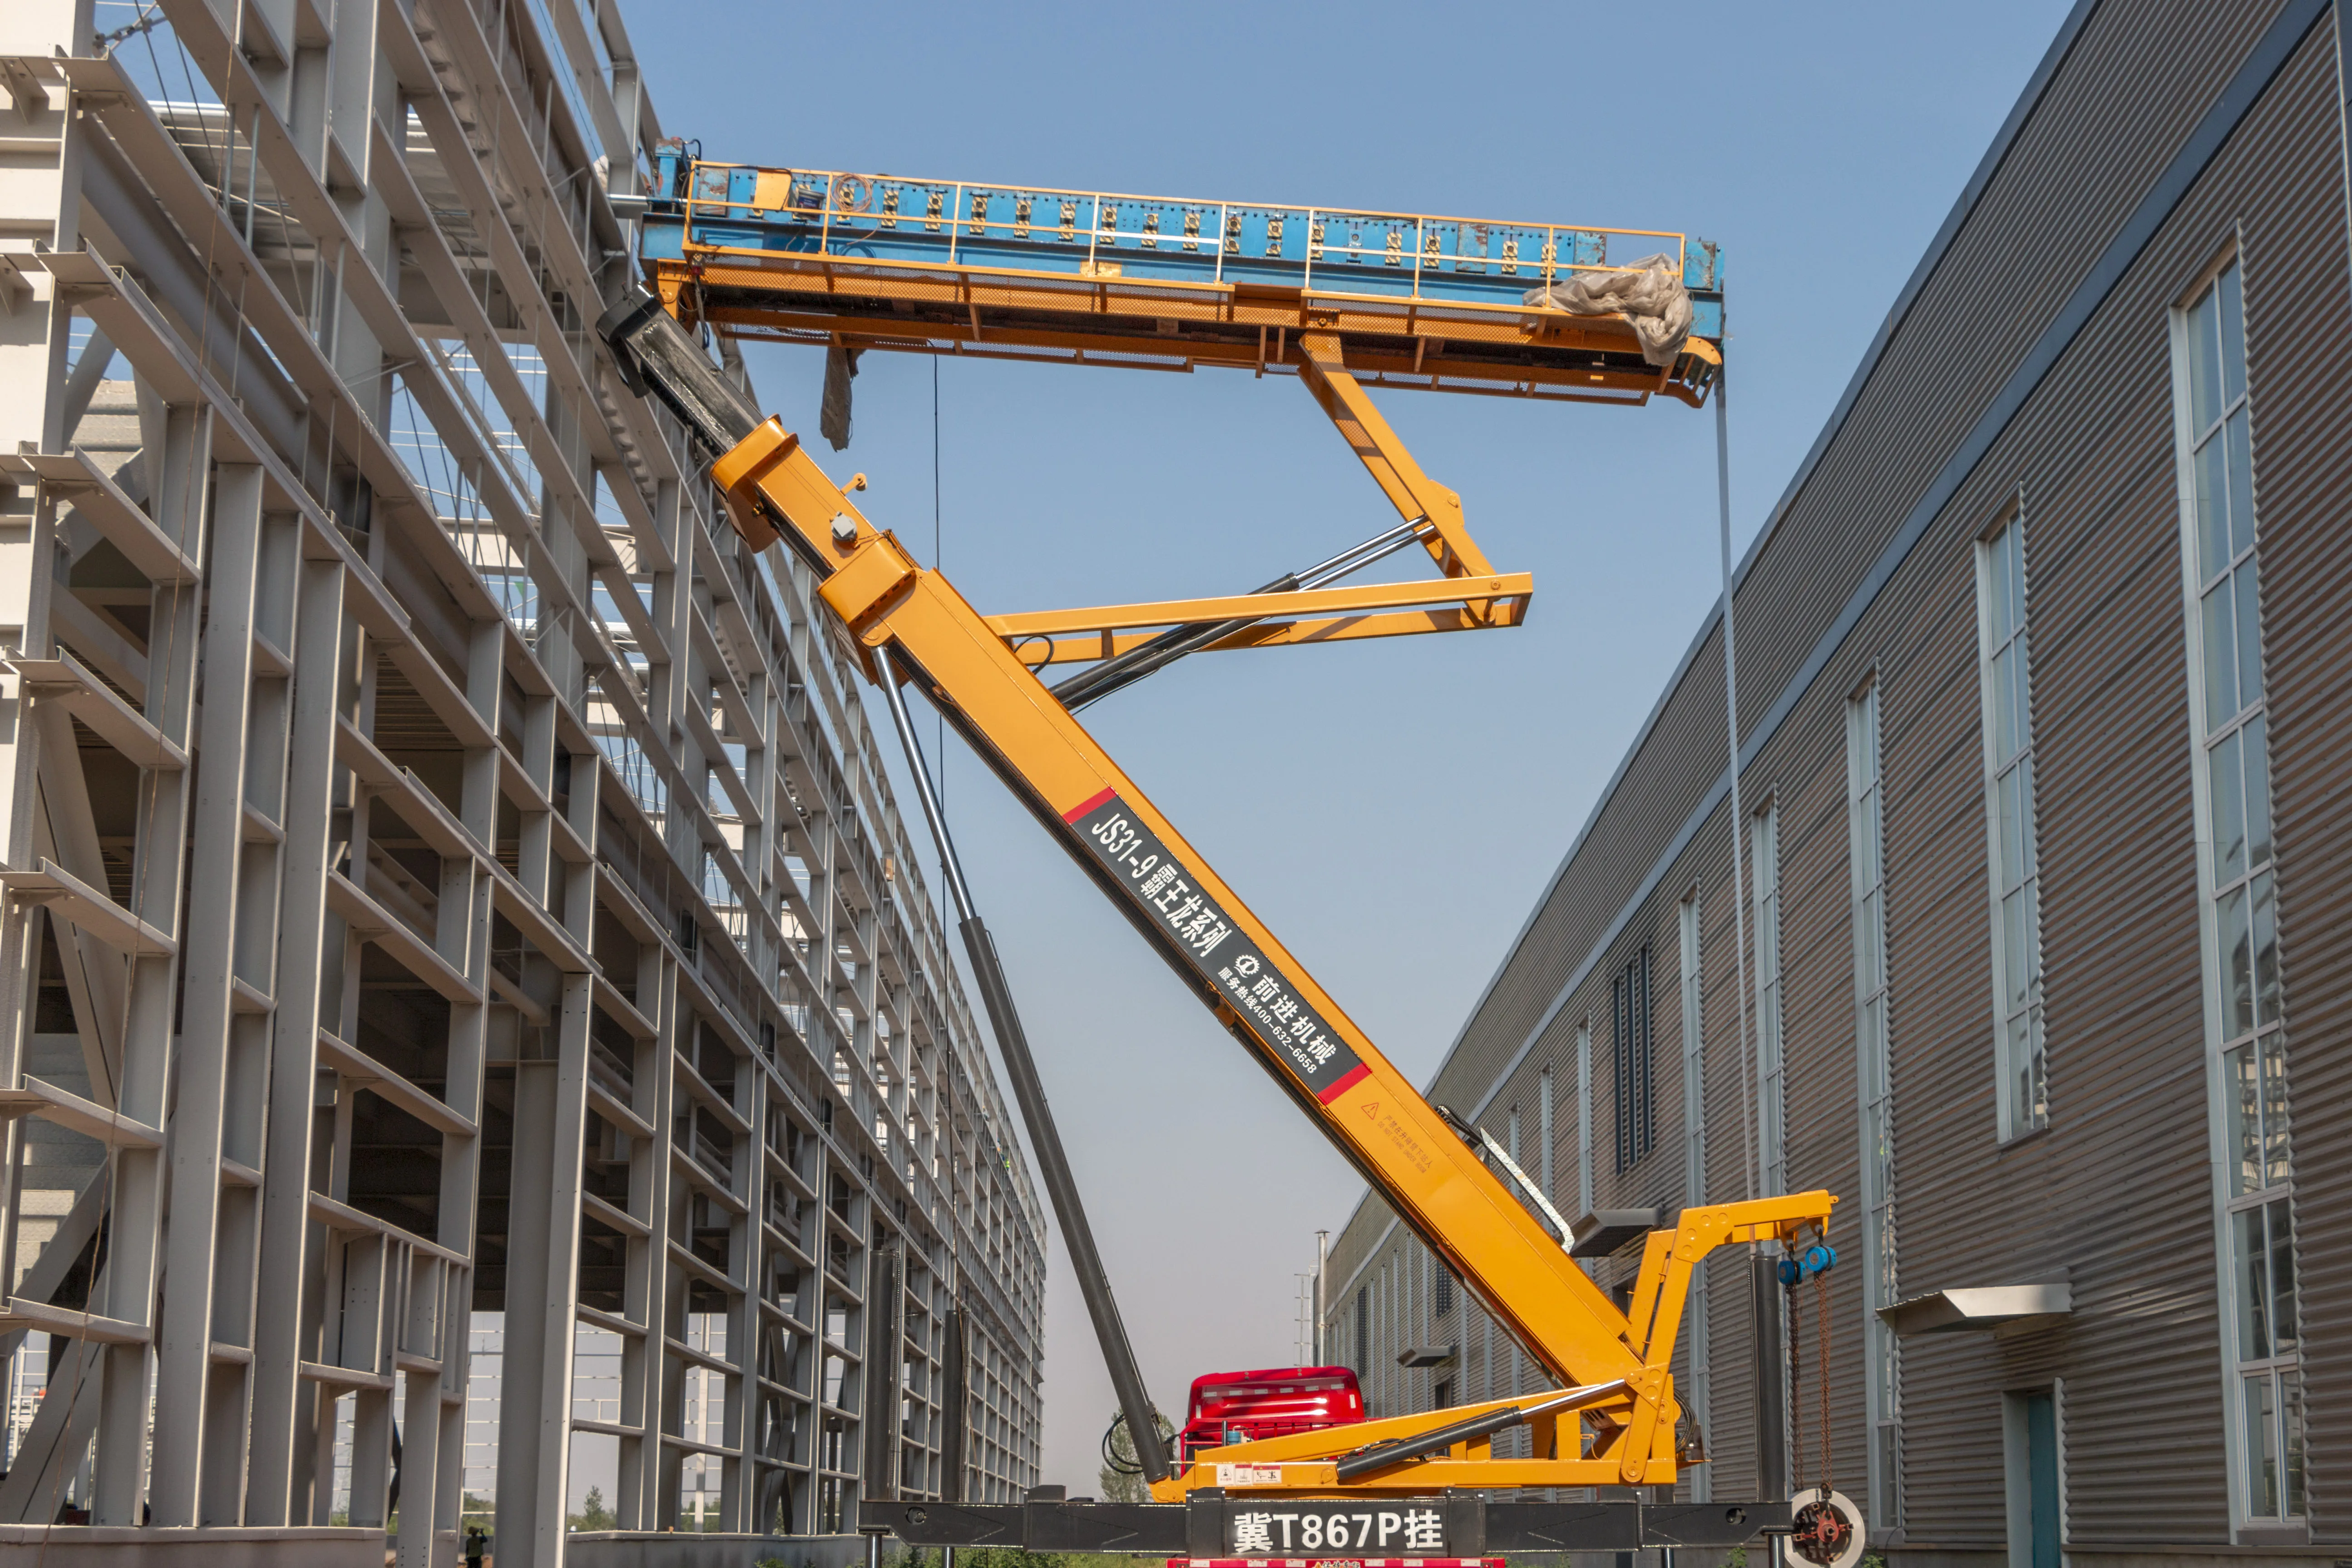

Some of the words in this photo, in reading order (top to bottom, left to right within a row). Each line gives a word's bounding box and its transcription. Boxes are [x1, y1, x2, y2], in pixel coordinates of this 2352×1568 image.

[1252, 974, 1336, 1065] 前进机械
[1384, 1128, 1393, 1137] NOT
[1391, 1136, 1404, 1150] STAND
[1403, 1149, 1417, 1162] UNDER
[1234, 1509, 1443, 1553] 冀T867P挂
